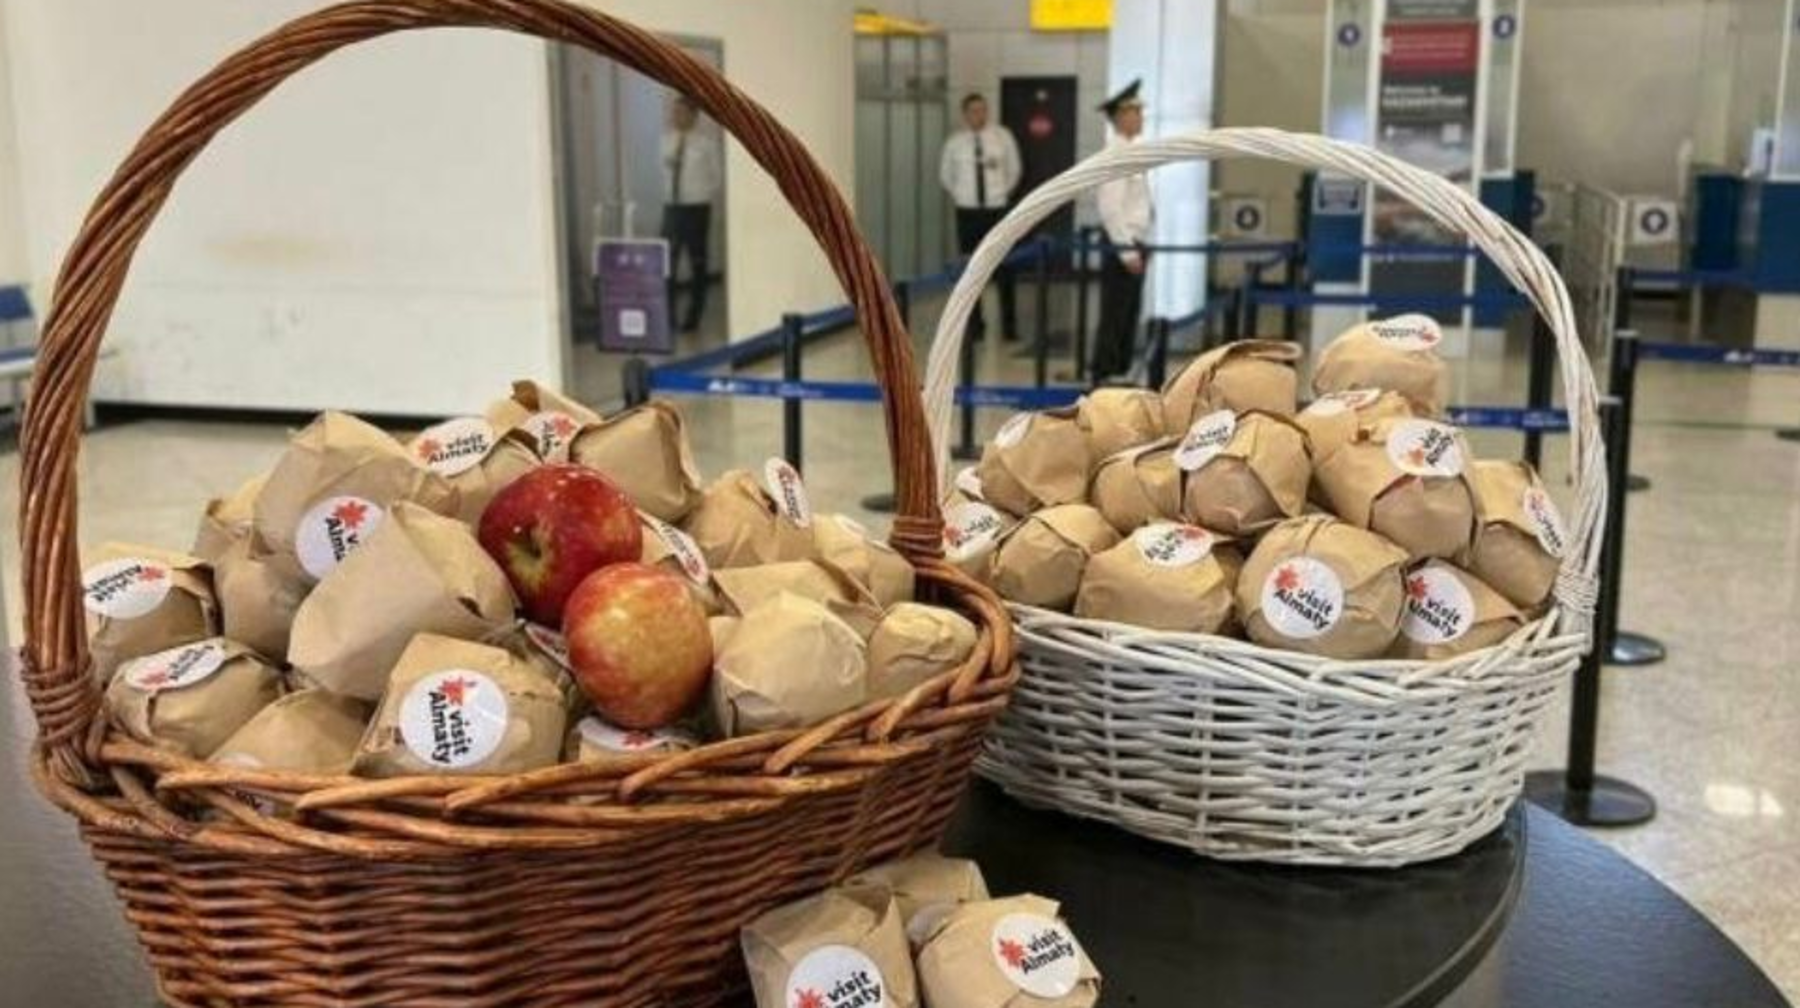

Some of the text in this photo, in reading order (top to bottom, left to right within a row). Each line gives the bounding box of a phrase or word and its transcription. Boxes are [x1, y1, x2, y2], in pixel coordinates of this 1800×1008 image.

[428, 443, 490, 464] Almaty
[446, 433, 484, 449] visit
[1273, 588, 1330, 631] Almaty
[1298, 589, 1334, 616] visit
[1426, 597, 1461, 625] visit
[428, 691, 451, 764] Almaty
[448, 709, 473, 756] visit
[1027, 929, 1063, 952] visit
[1020, 941, 1074, 974] Almaty
[827, 970, 872, 1002] visit
